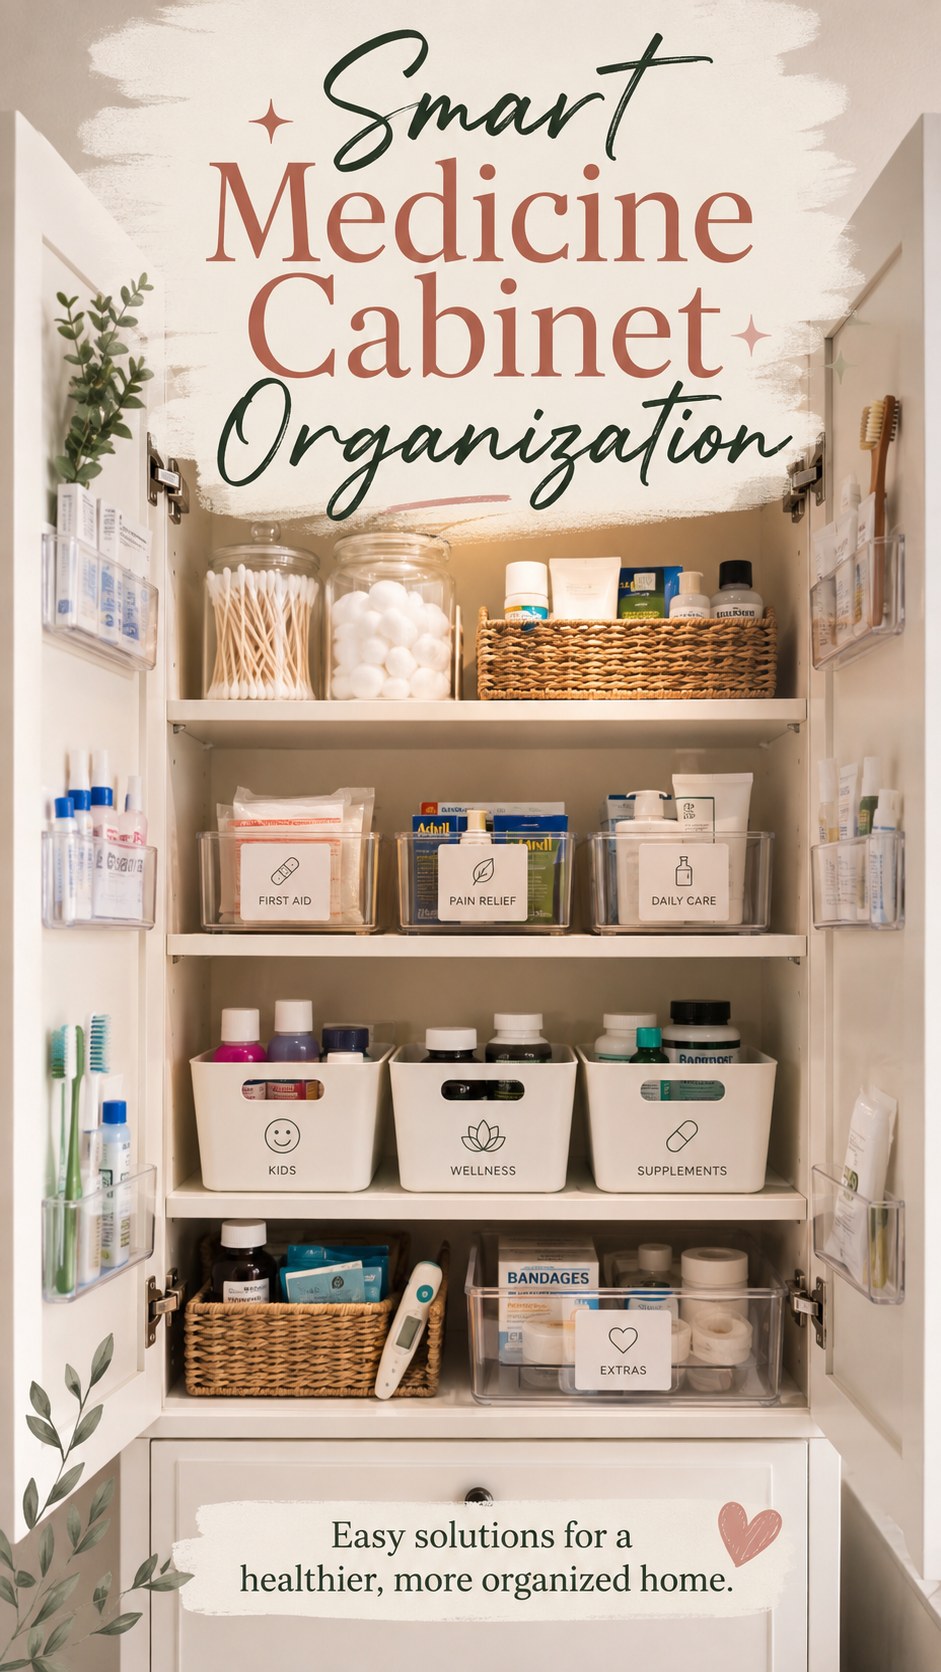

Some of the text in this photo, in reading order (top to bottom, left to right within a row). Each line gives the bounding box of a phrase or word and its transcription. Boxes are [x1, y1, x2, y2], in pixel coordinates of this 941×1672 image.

[258, 895, 312, 906] FIRST AID
[449, 896, 517, 906] PAIN RELIEF
[651, 895, 717, 906] DAILY CARE
[268, 1165, 297, 1176] KIDS
[450, 1165, 516, 1176] WELLNESS
[637, 1165, 728, 1177] SUPPLEMENTS
[507, 1271, 590, 1285] BANDAGES
[600, 1365, 647, 1376] EXTRAS
